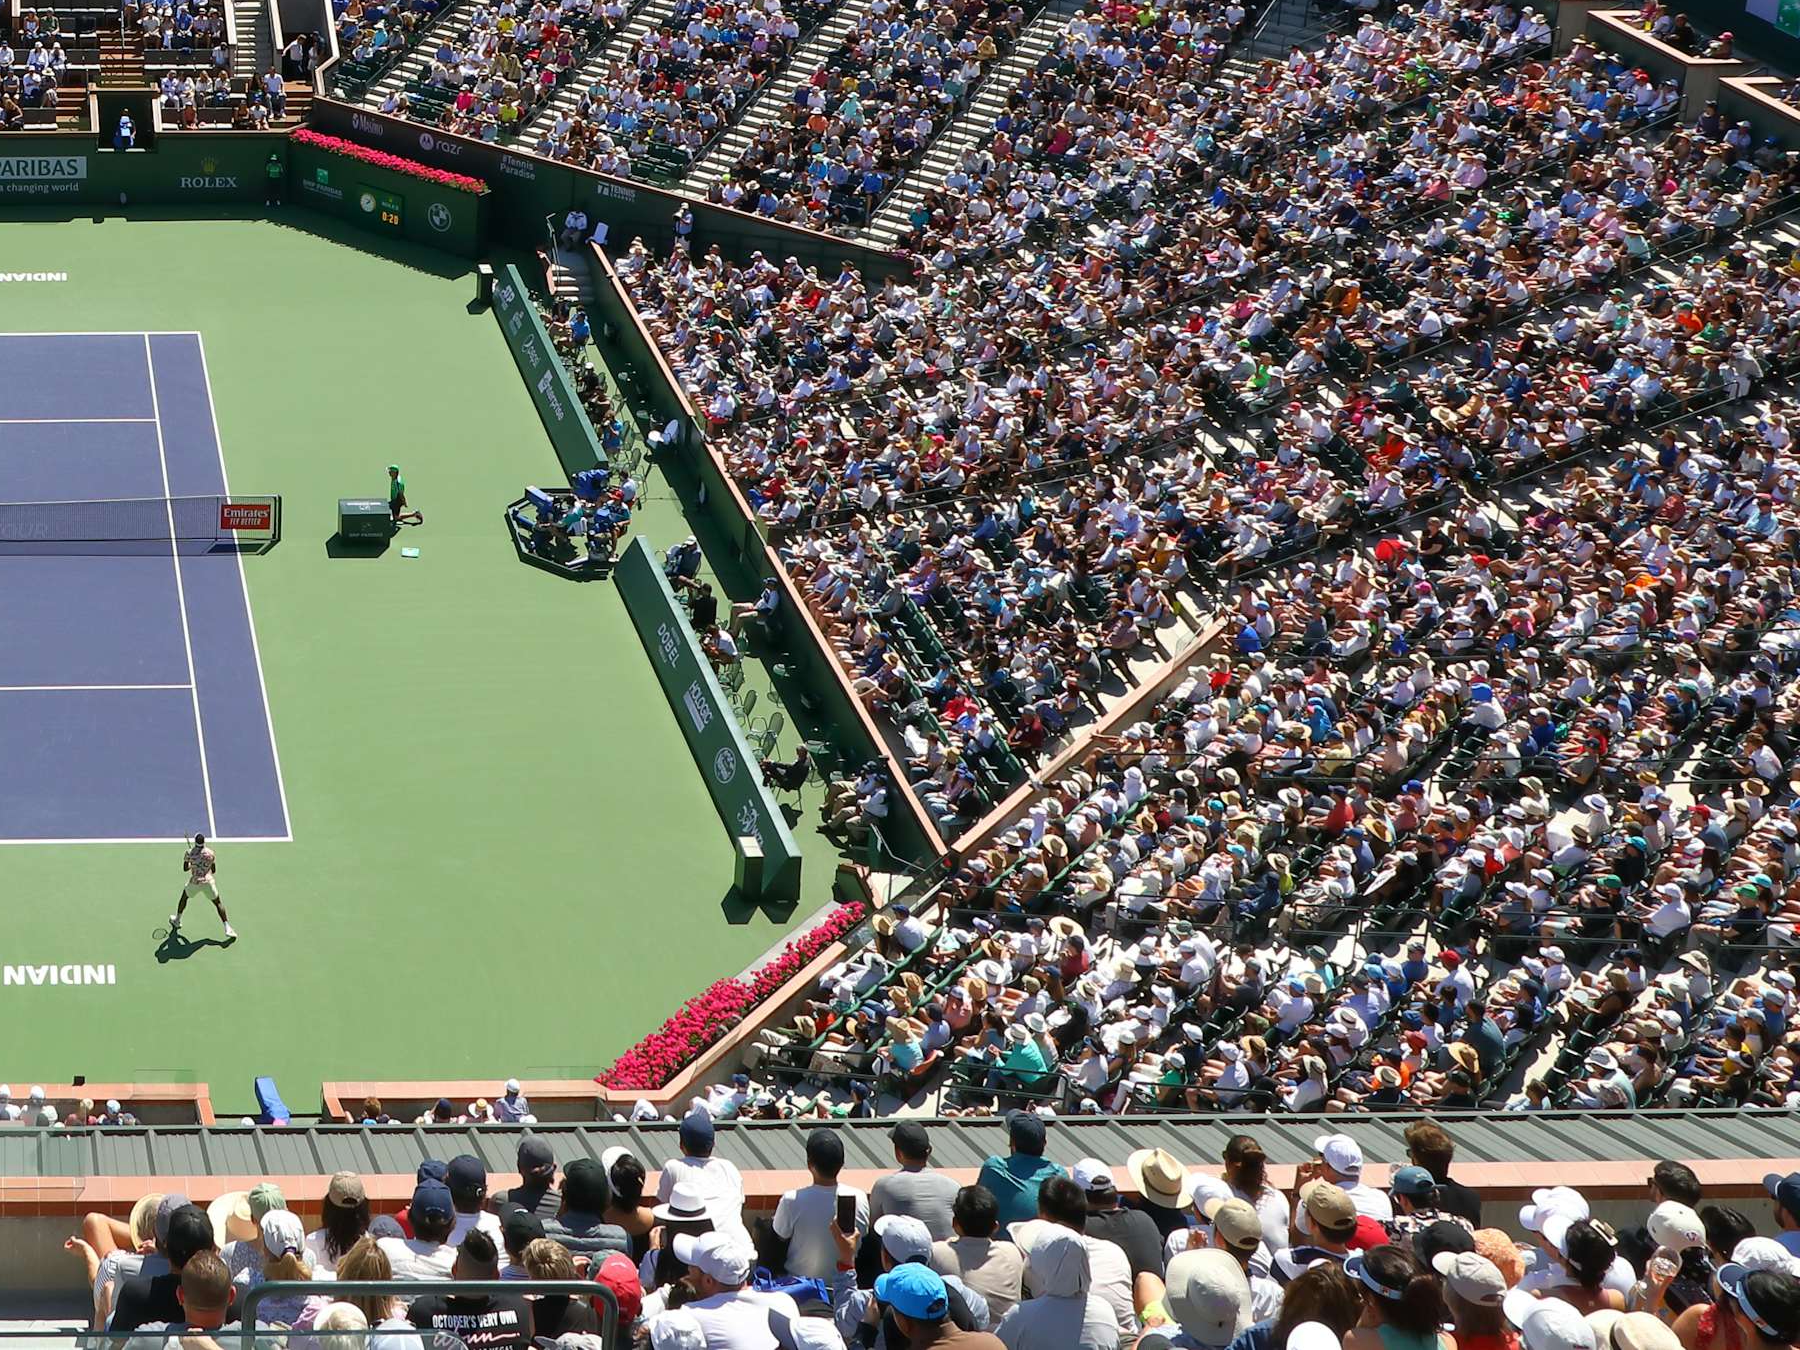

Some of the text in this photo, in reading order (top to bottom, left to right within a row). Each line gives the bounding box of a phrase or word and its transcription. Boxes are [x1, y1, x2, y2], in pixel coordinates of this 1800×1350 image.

[436, 141, 463, 155] razr
[500, 163, 536, 180] Paradise
[6, 183, 49, 194] changing
[52, 182, 79, 192] world
[180, 176, 237, 188] ROLEX
[610, 184, 636, 198] TENNIS
[381, 211, 399, 225] 0:20
[223, 508, 269, 518] Emirates
[657, 623, 680, 668] DOBEL
[689, 680, 713, 725] HOLOGIC
[3, 964, 116, 985] INDIAN
[477, 1312, 498, 1328] VERY
[499, 1310, 518, 1325] OWN
